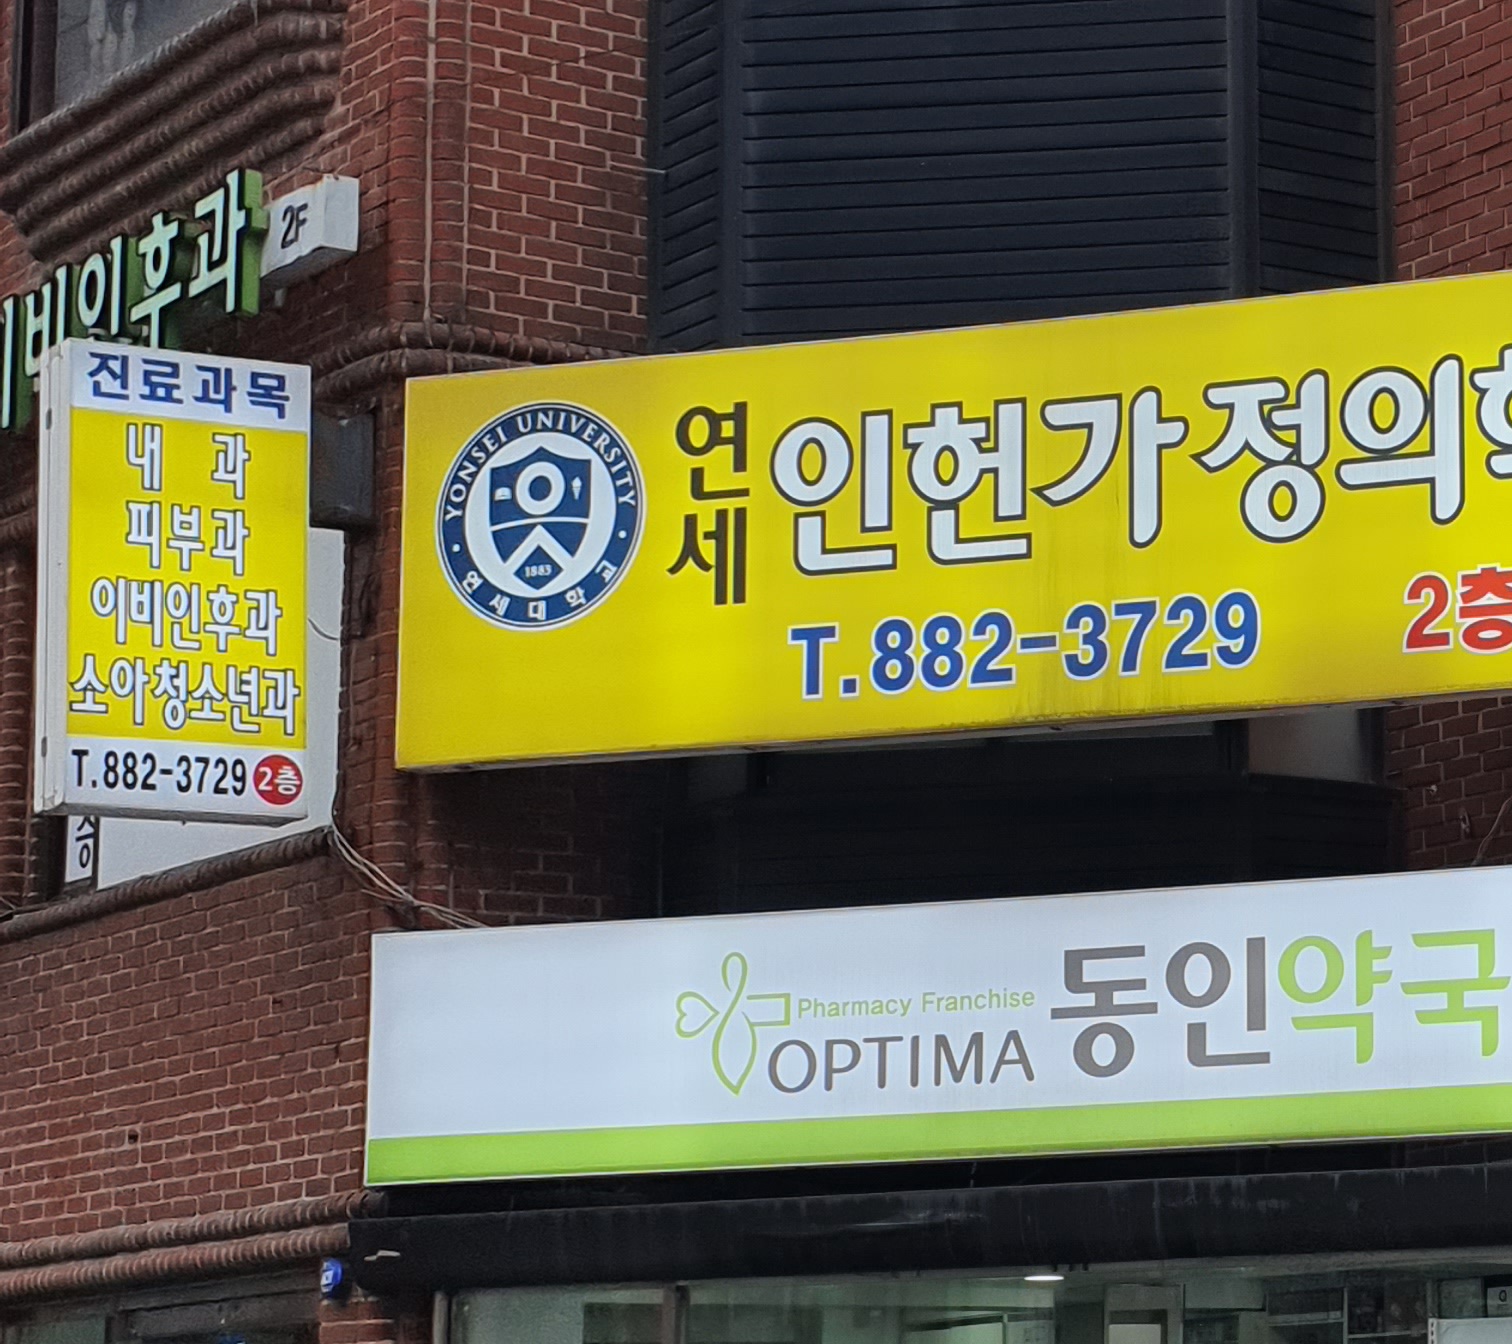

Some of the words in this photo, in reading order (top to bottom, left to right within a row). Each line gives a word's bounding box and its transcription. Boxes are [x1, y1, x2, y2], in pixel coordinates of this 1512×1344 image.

[281, 203, 307, 250] 2F
[88, 352, 290, 419] 진료과목
[445, 427, 508, 522] YONSEI
[517, 410, 637, 506] UNIVERSITY
[125, 501, 250, 576] 피부과
[667, 401, 750, 605] 연세
[91, 576, 283, 656] 이비인후과
[462, 560, 618, 621] 연세대학교
[788, 590, 1262, 699] T.882-3729
[70, 654, 301, 737] 소아청소년과
[71, 748, 247, 799] T.882-3729
[257, 762, 301, 797] 2층
[797, 996, 912, 1019] Pharmacy
[921, 987, 1035, 1013] Franchise
[1050, 928, 1512, 1078] 동인약국
[768, 1029, 1035, 1094] OPTIMA
